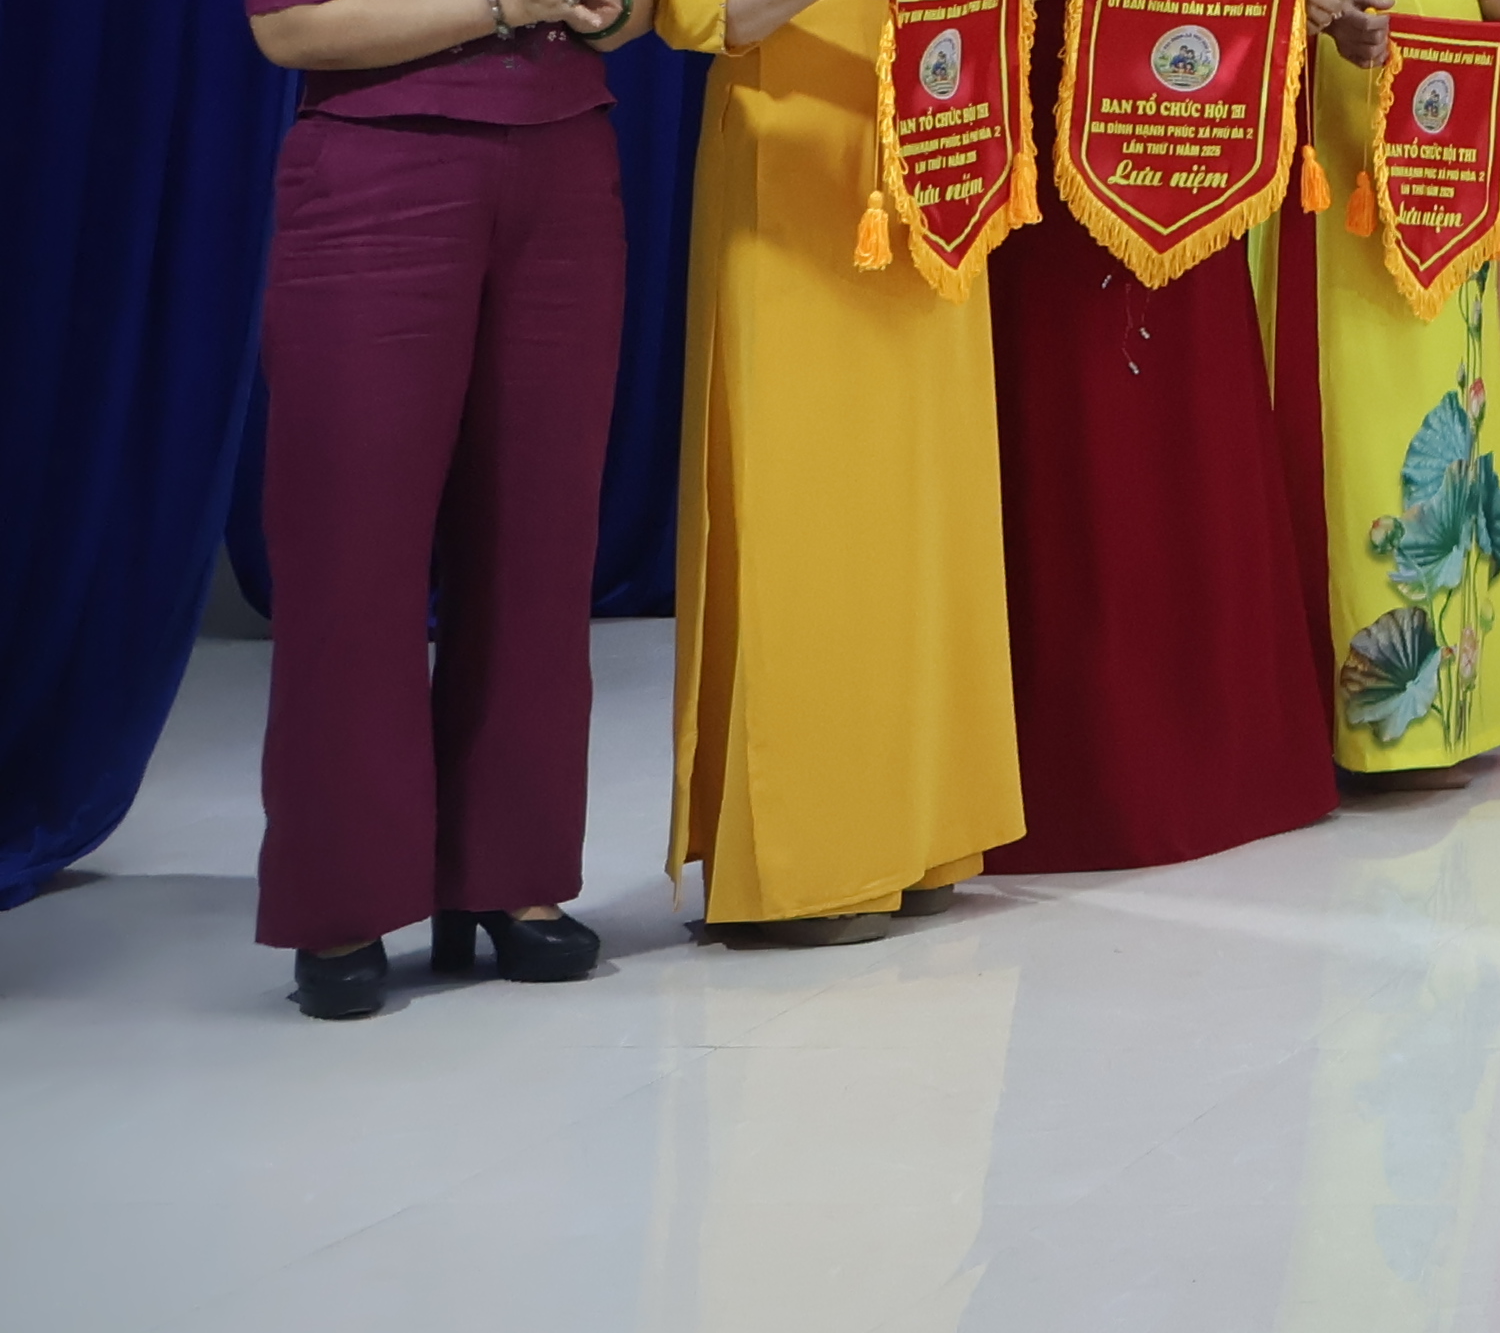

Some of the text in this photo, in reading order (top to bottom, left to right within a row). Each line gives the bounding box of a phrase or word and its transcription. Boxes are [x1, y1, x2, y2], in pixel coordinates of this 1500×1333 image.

[1101, 98, 1133, 113] BAN
[1137, 93, 1157, 115] TỔ
[1160, 98, 1201, 117] CHỨC
[1204, 100, 1229, 122] HỘI
